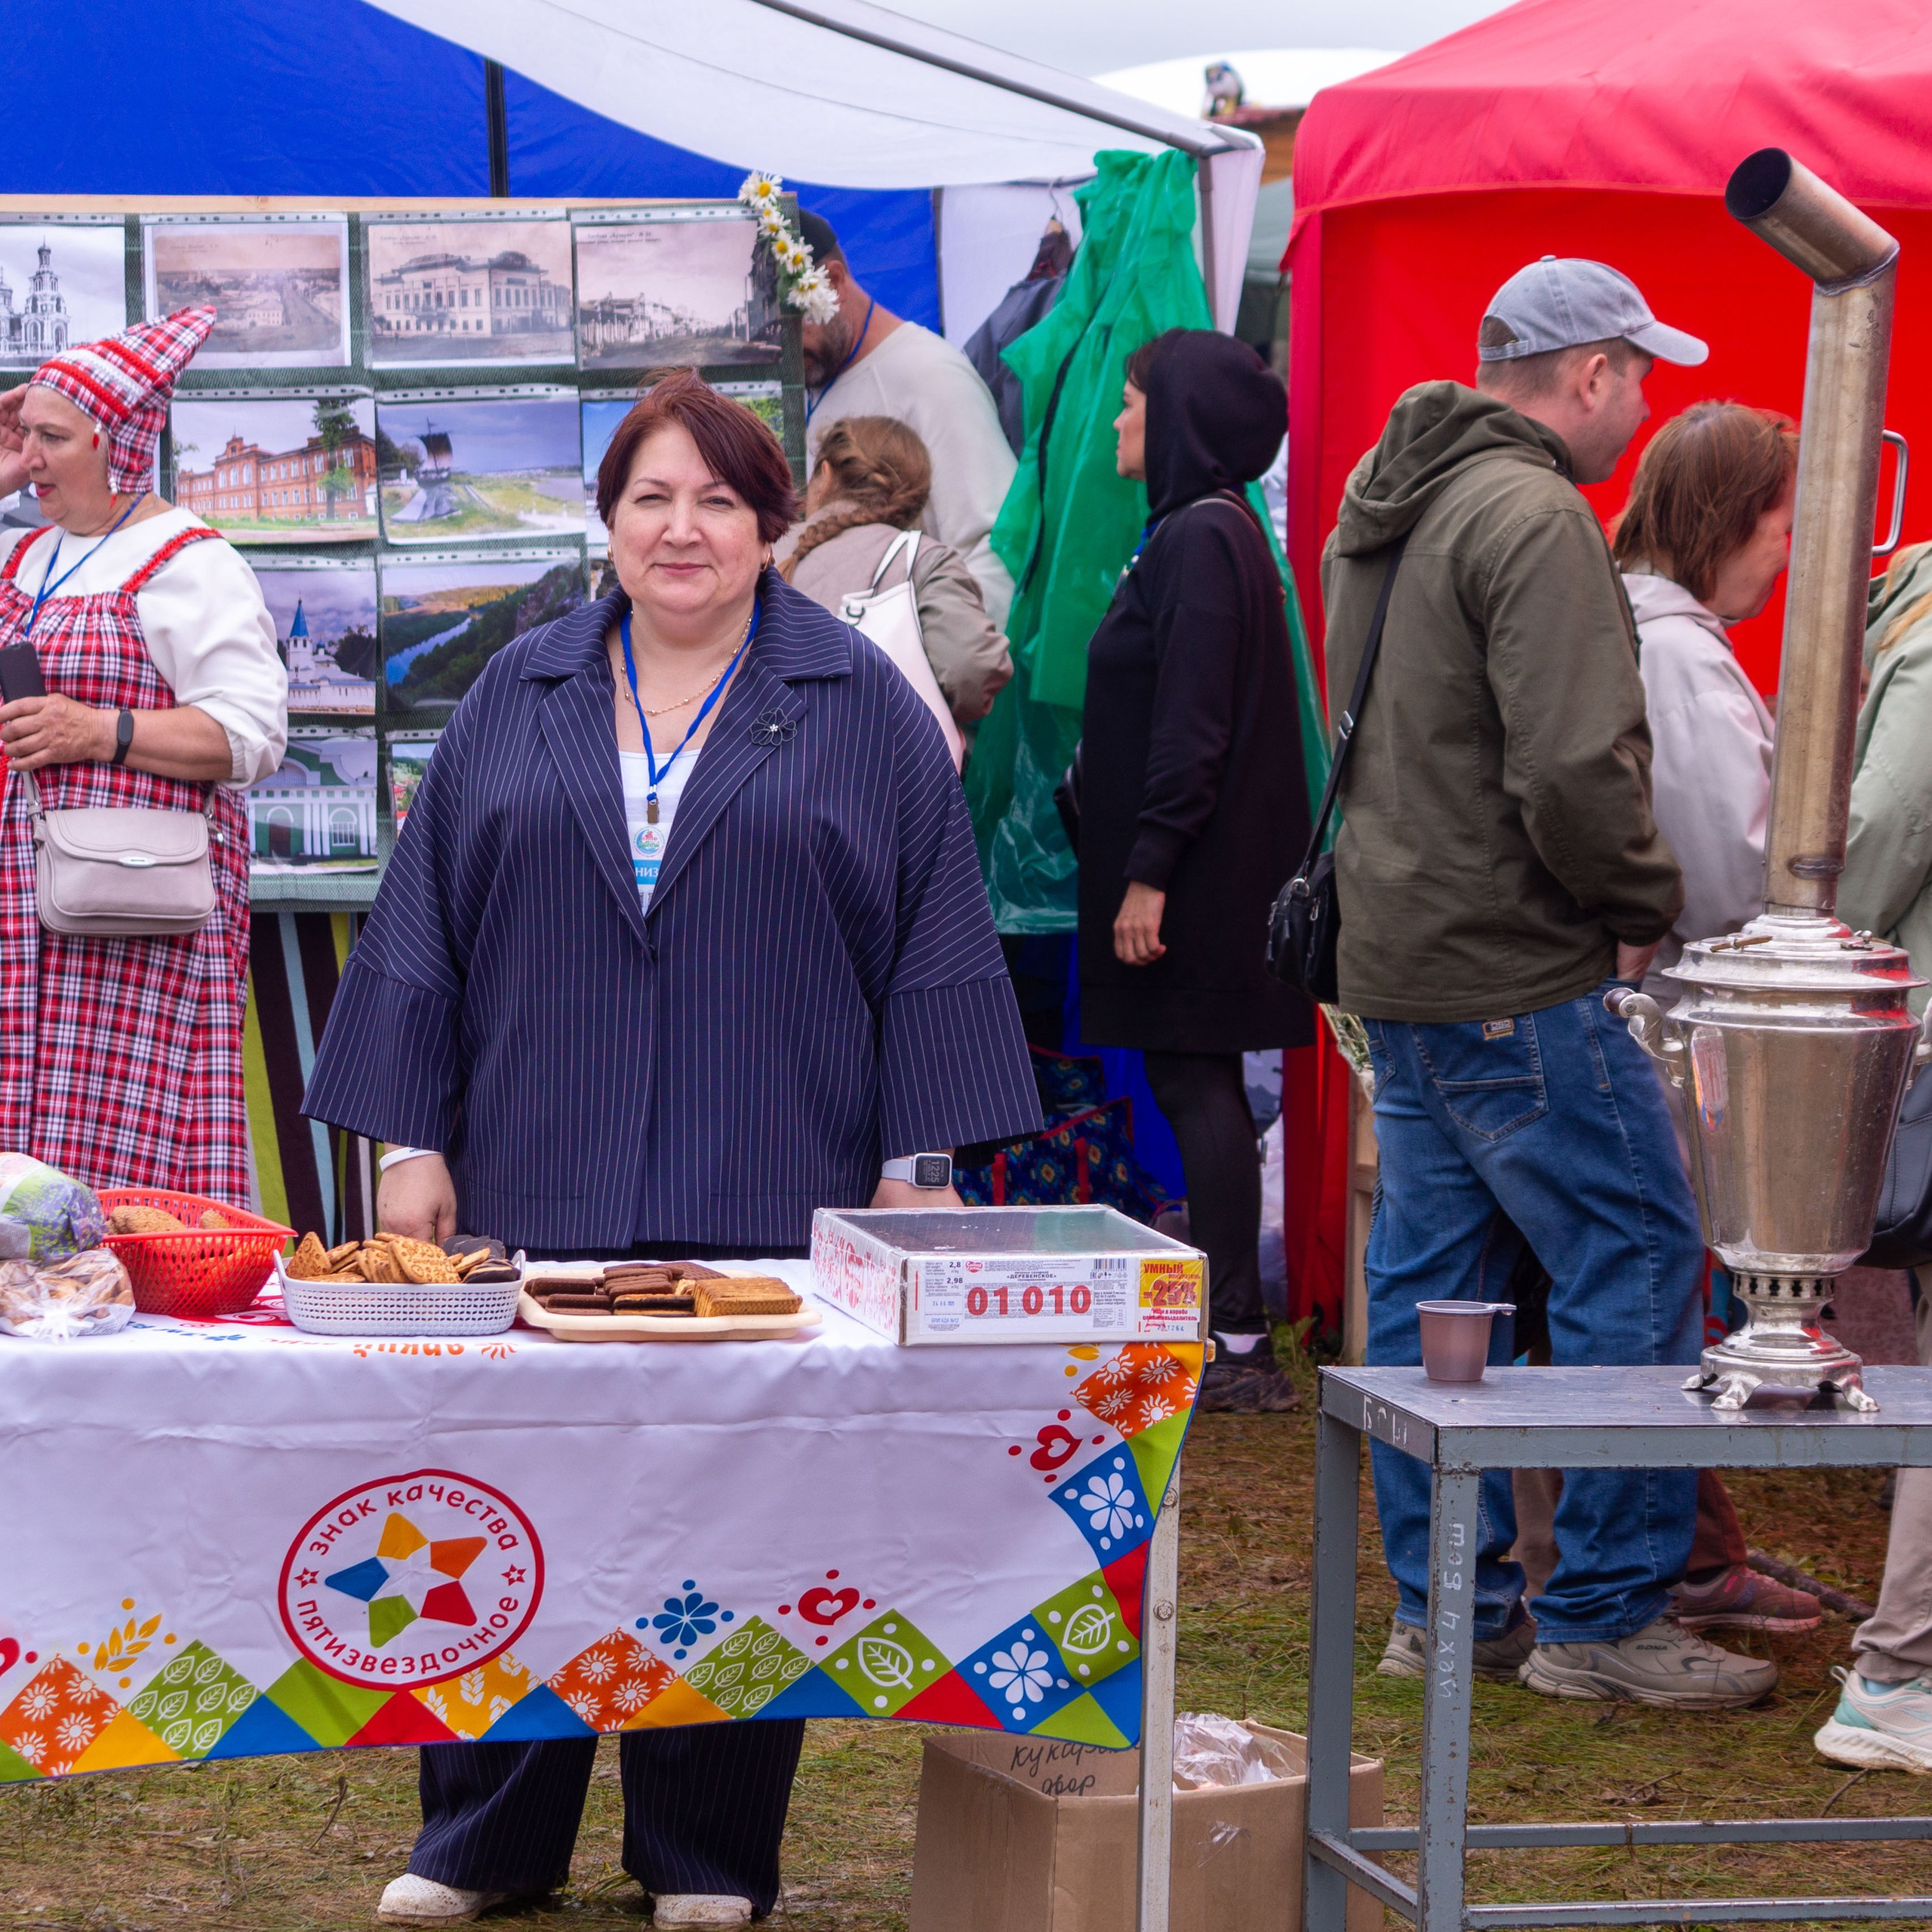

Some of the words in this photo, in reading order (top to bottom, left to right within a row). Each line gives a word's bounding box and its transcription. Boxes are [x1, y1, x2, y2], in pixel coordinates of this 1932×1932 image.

[1143, 1263, 1184, 1274] УМНЫЙ
[309, 1497, 377, 1556] знак
[387, 1483, 520, 1551] качества
[297, 1595, 520, 1675] пятизвездочное
